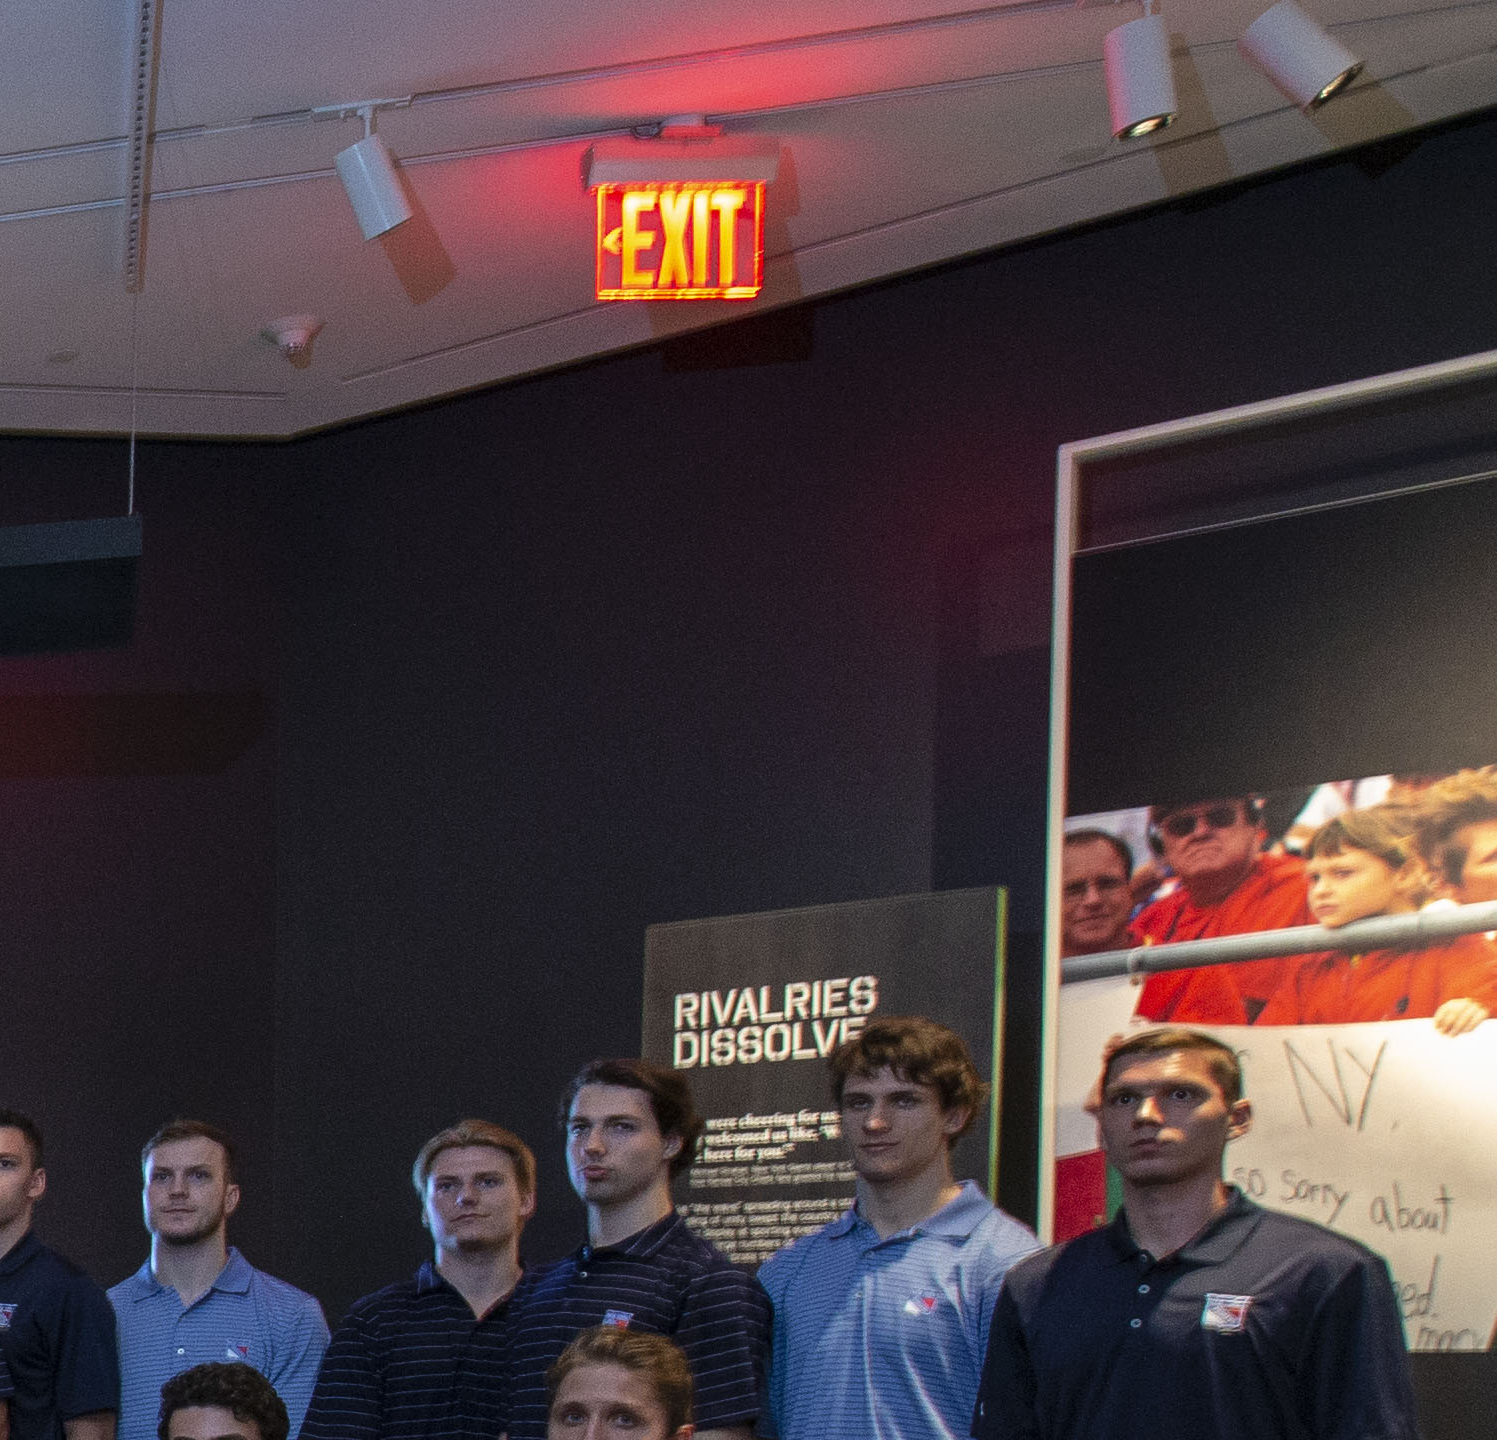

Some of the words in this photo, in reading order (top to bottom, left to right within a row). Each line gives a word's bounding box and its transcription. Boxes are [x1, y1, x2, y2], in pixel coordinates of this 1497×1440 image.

[621, 188, 746, 287] EXIT
[674, 976, 880, 1031] RIVALRIES
[704, 1126, 771, 1147] welcomed
[738, 1112, 797, 1130] cheering
[797, 1108, 821, 1126] for
[734, 1144, 757, 1161] for
[1369, 1181, 1454, 1234] about
